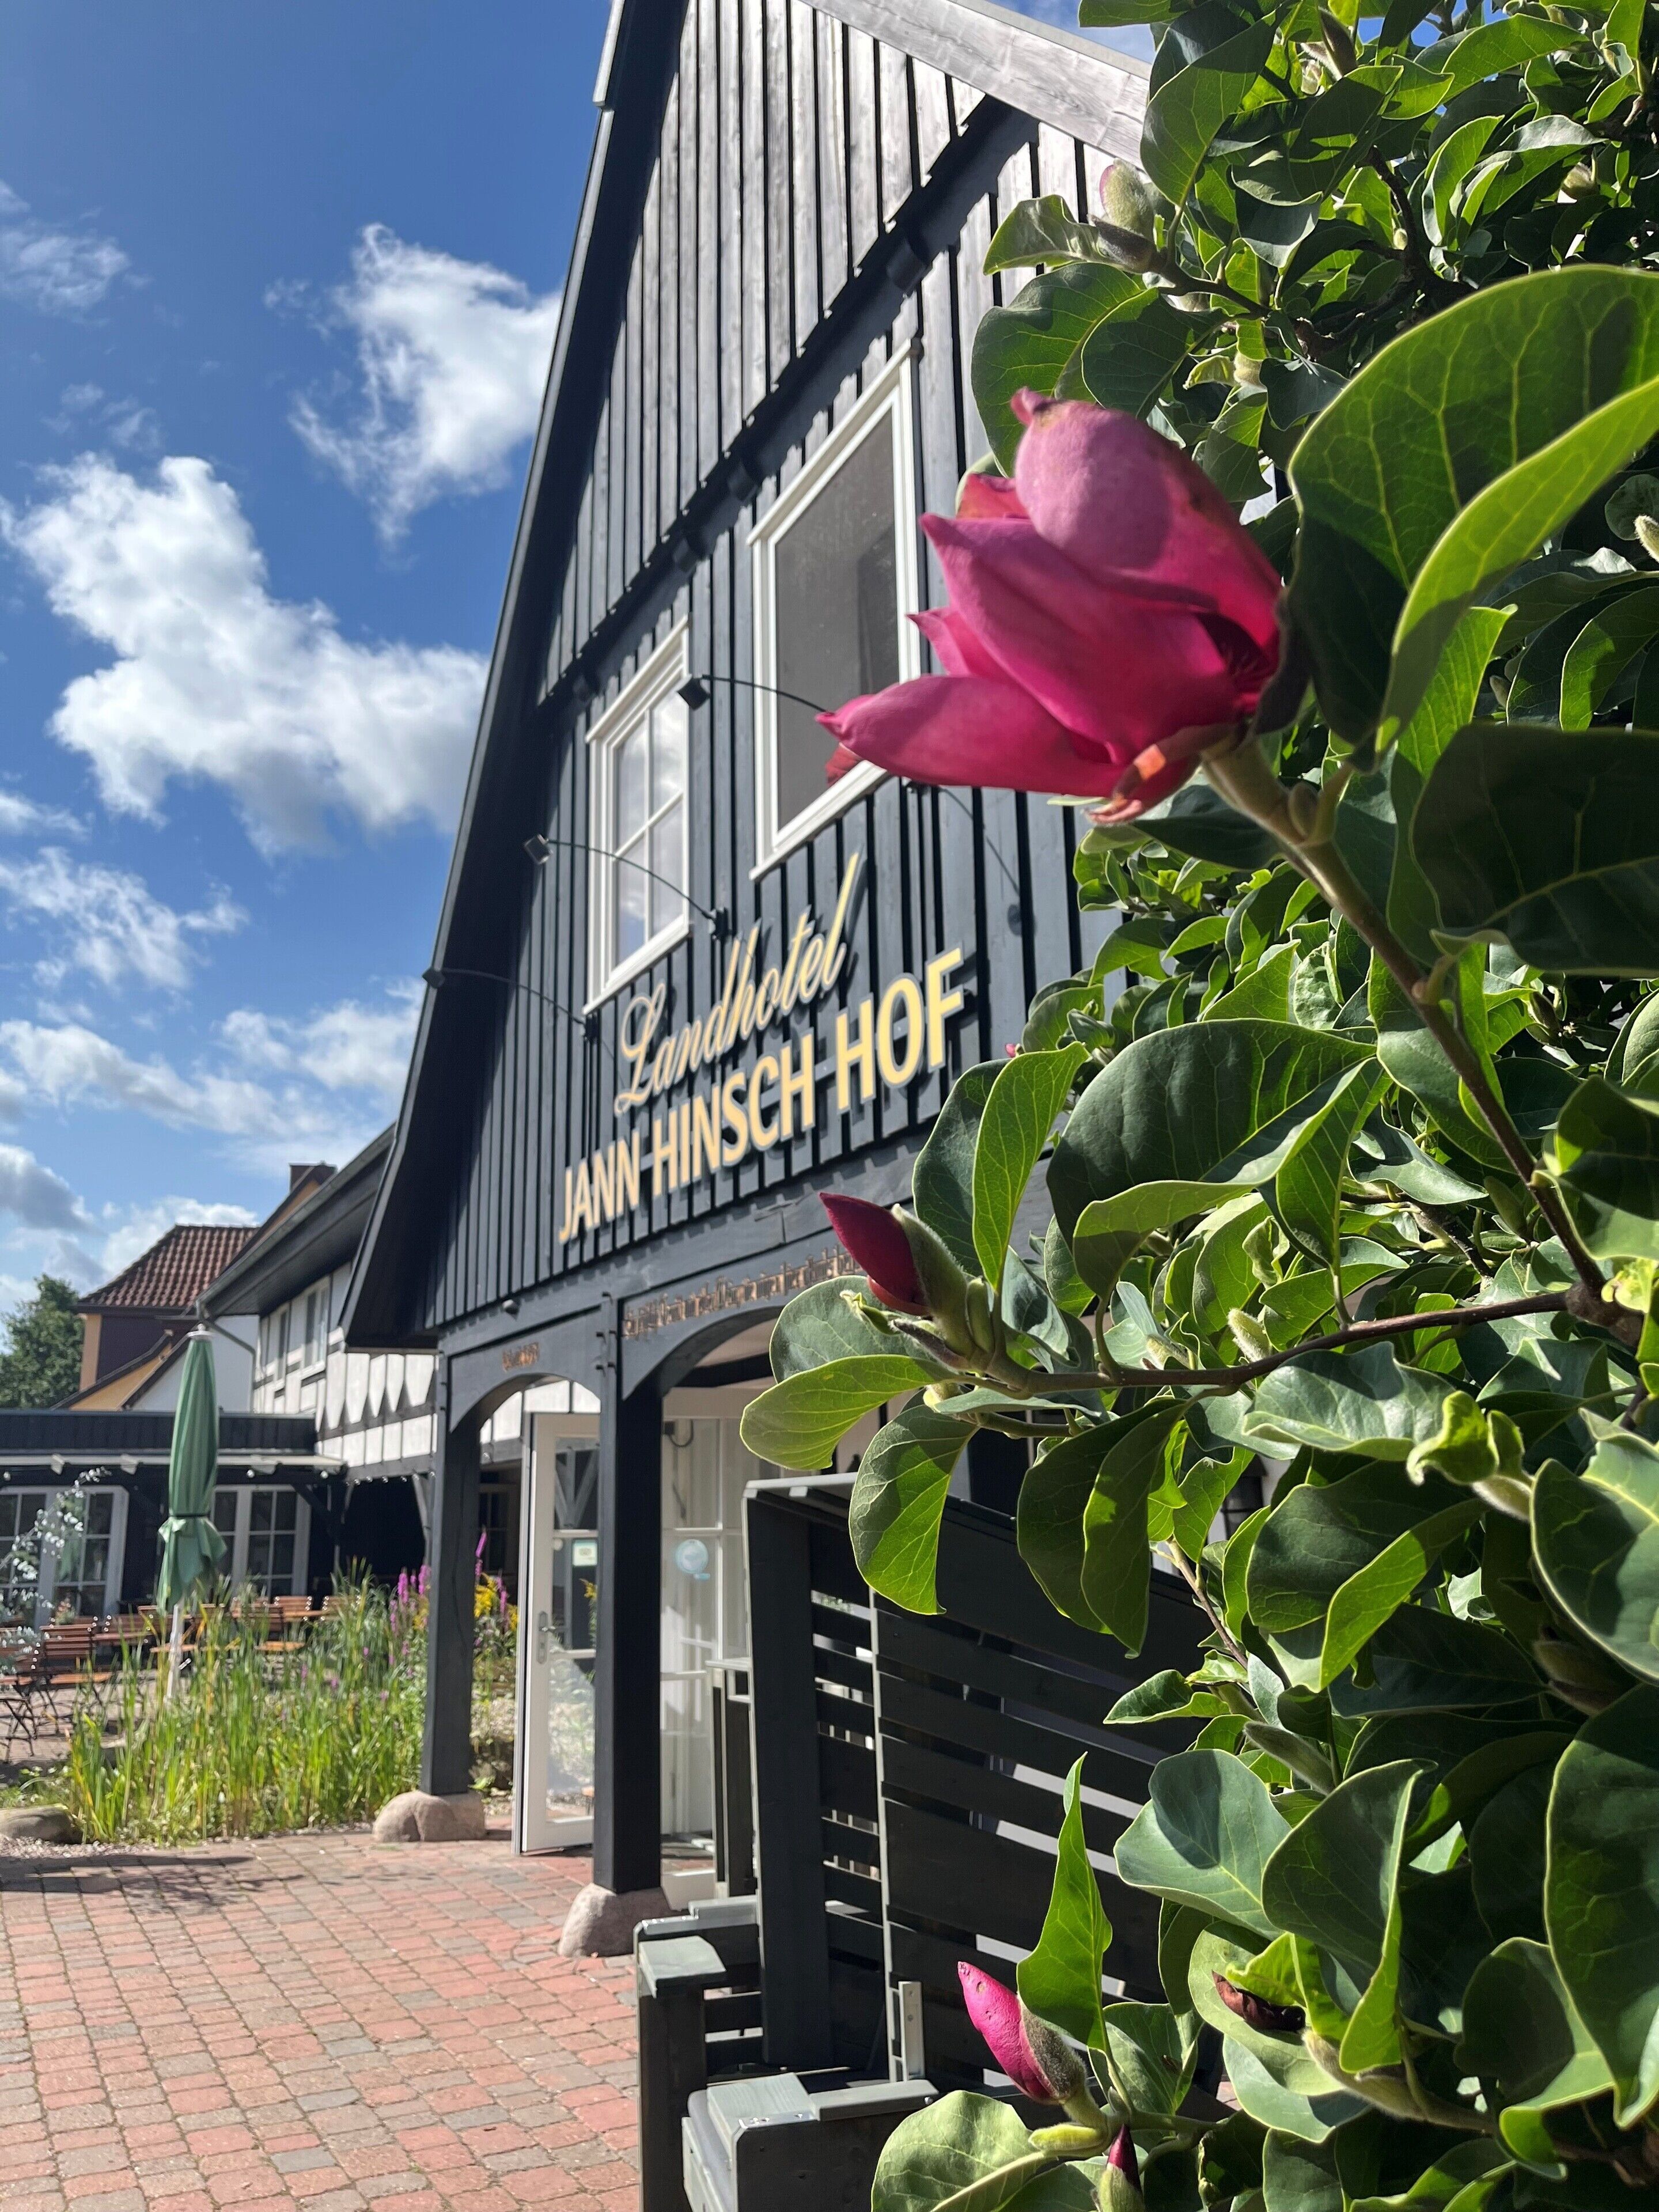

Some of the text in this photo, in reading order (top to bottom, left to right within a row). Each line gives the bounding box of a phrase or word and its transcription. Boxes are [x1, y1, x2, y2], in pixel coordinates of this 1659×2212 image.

[558, 947, 962, 1243] JANN HINSCH HOF
[614, 851, 859, 1115] Landhotel
